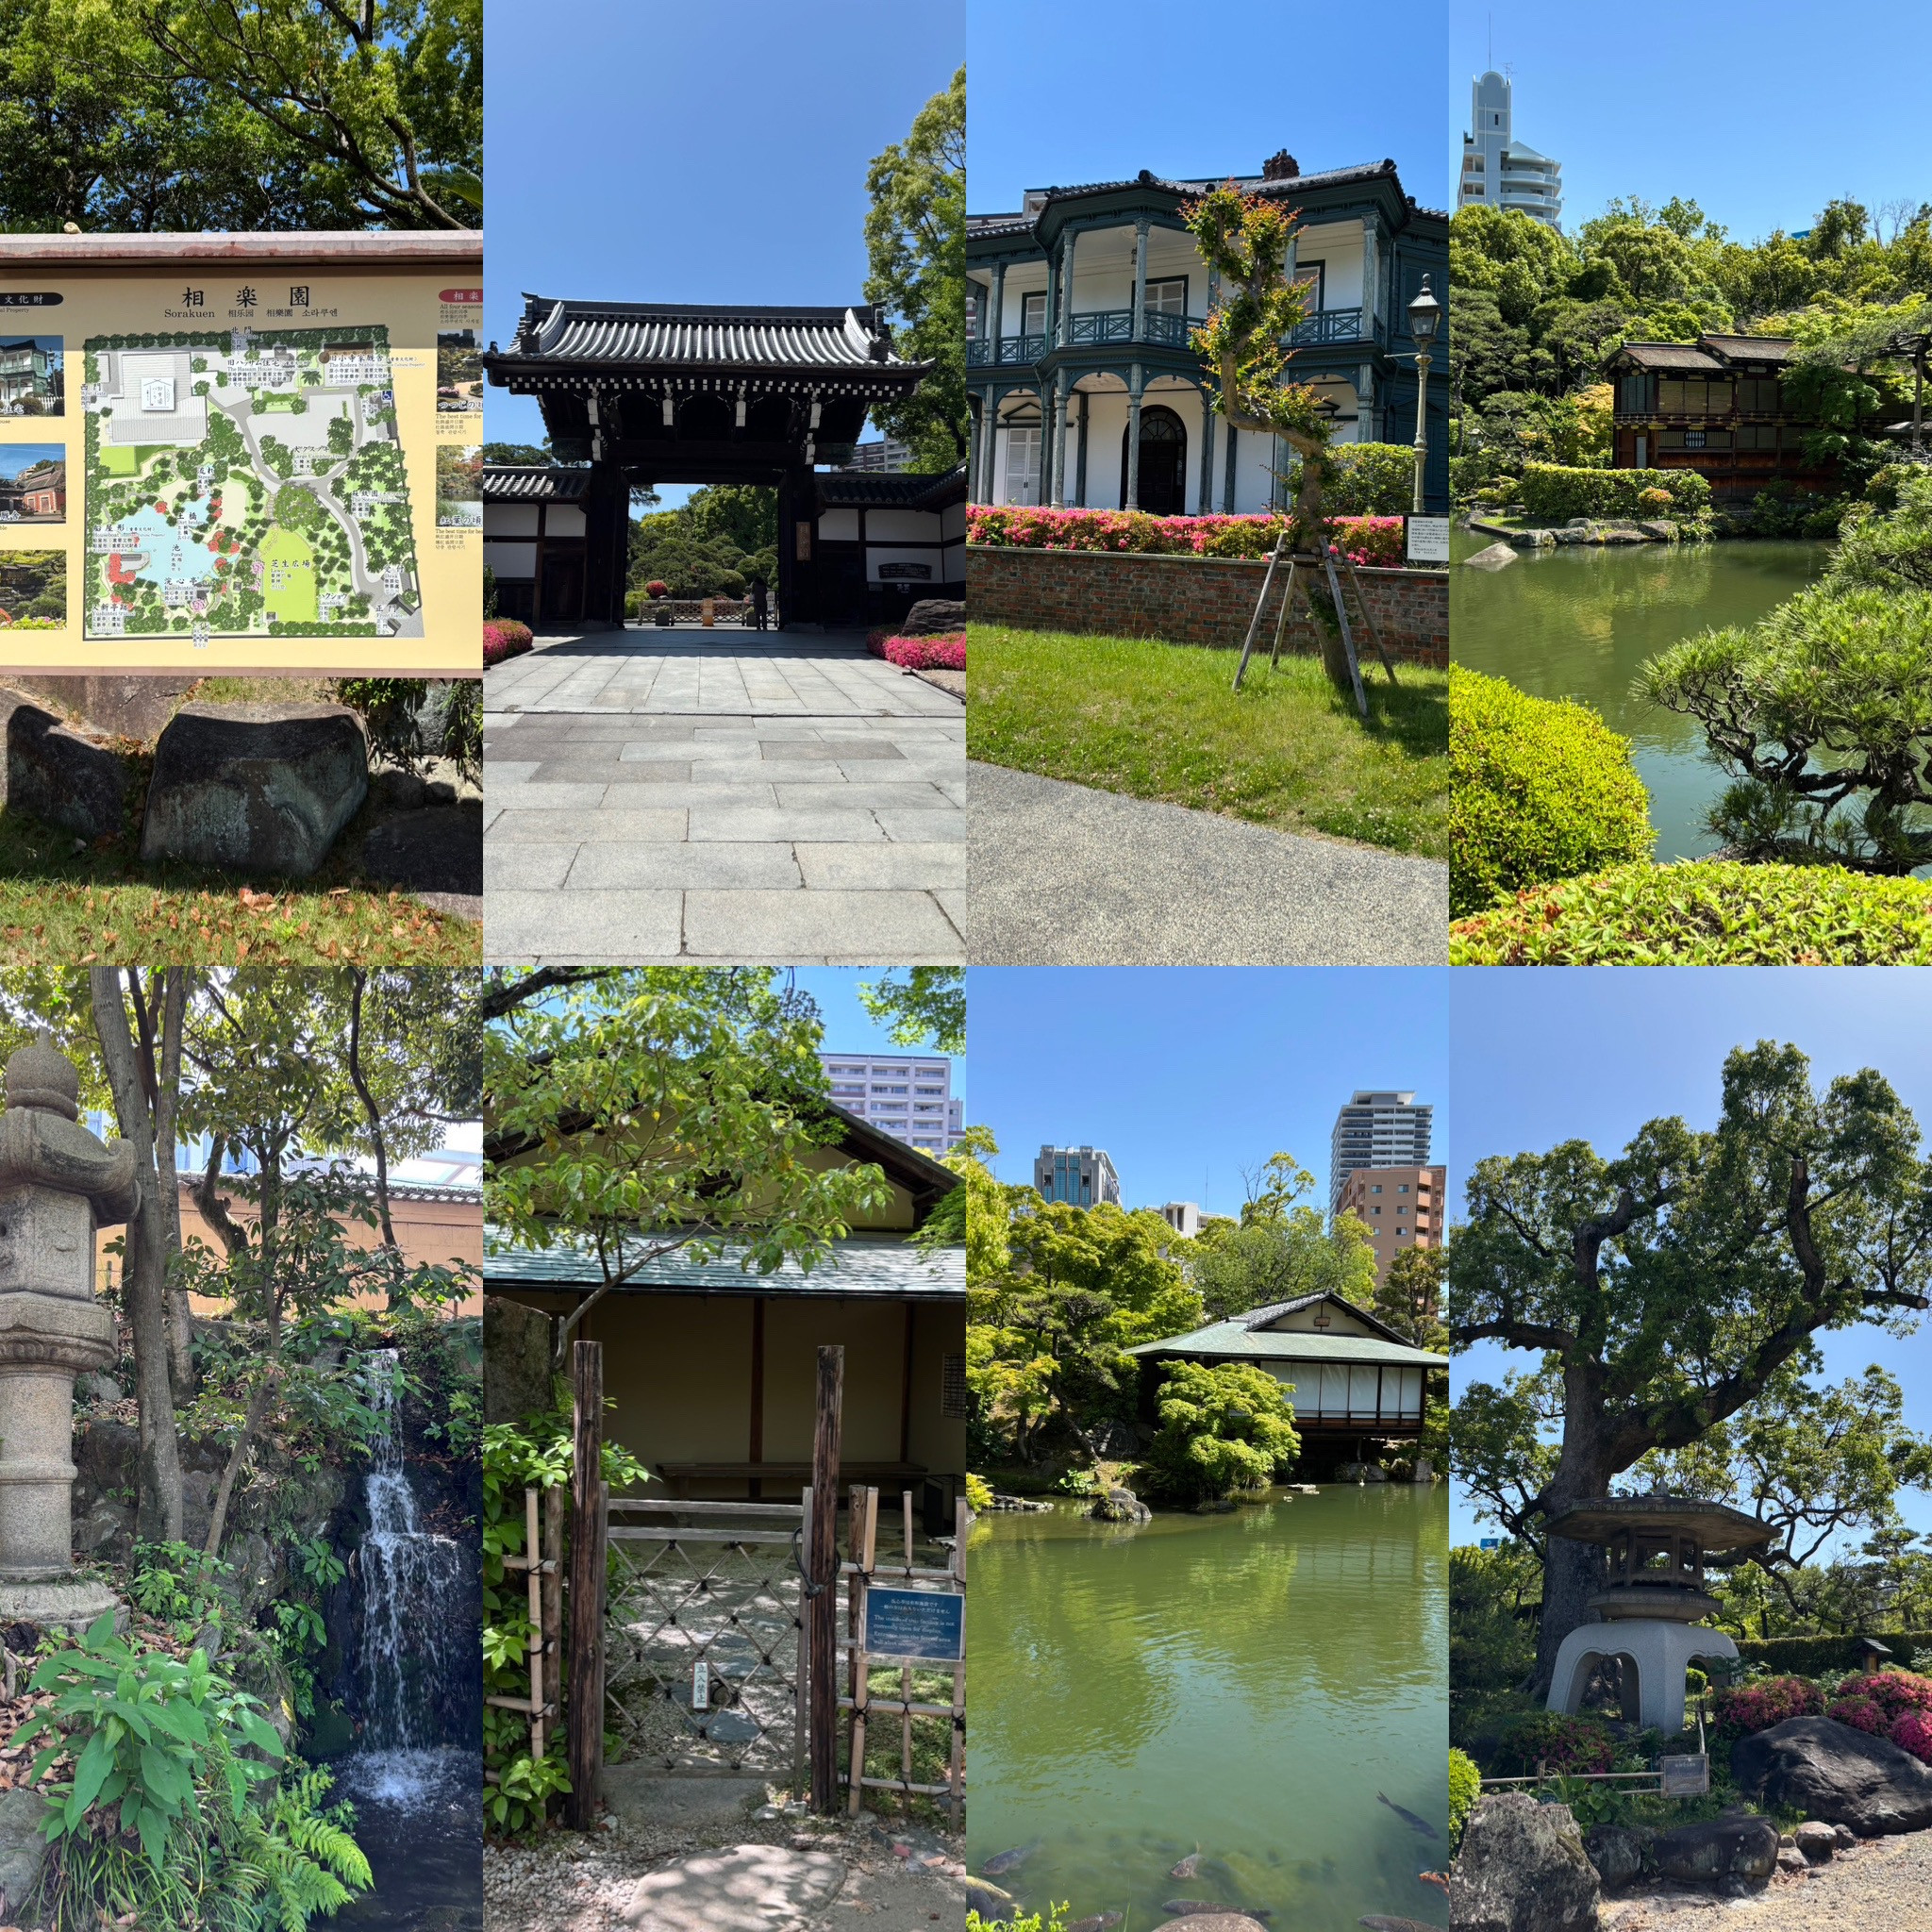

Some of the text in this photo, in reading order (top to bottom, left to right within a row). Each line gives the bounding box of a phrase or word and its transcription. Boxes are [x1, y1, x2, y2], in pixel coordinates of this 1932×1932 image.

[182, 286, 309, 308] 相楽園
[164, 308, 215, 318] Sorakuen
[696, 1664, 707, 1703] 立入禁止
